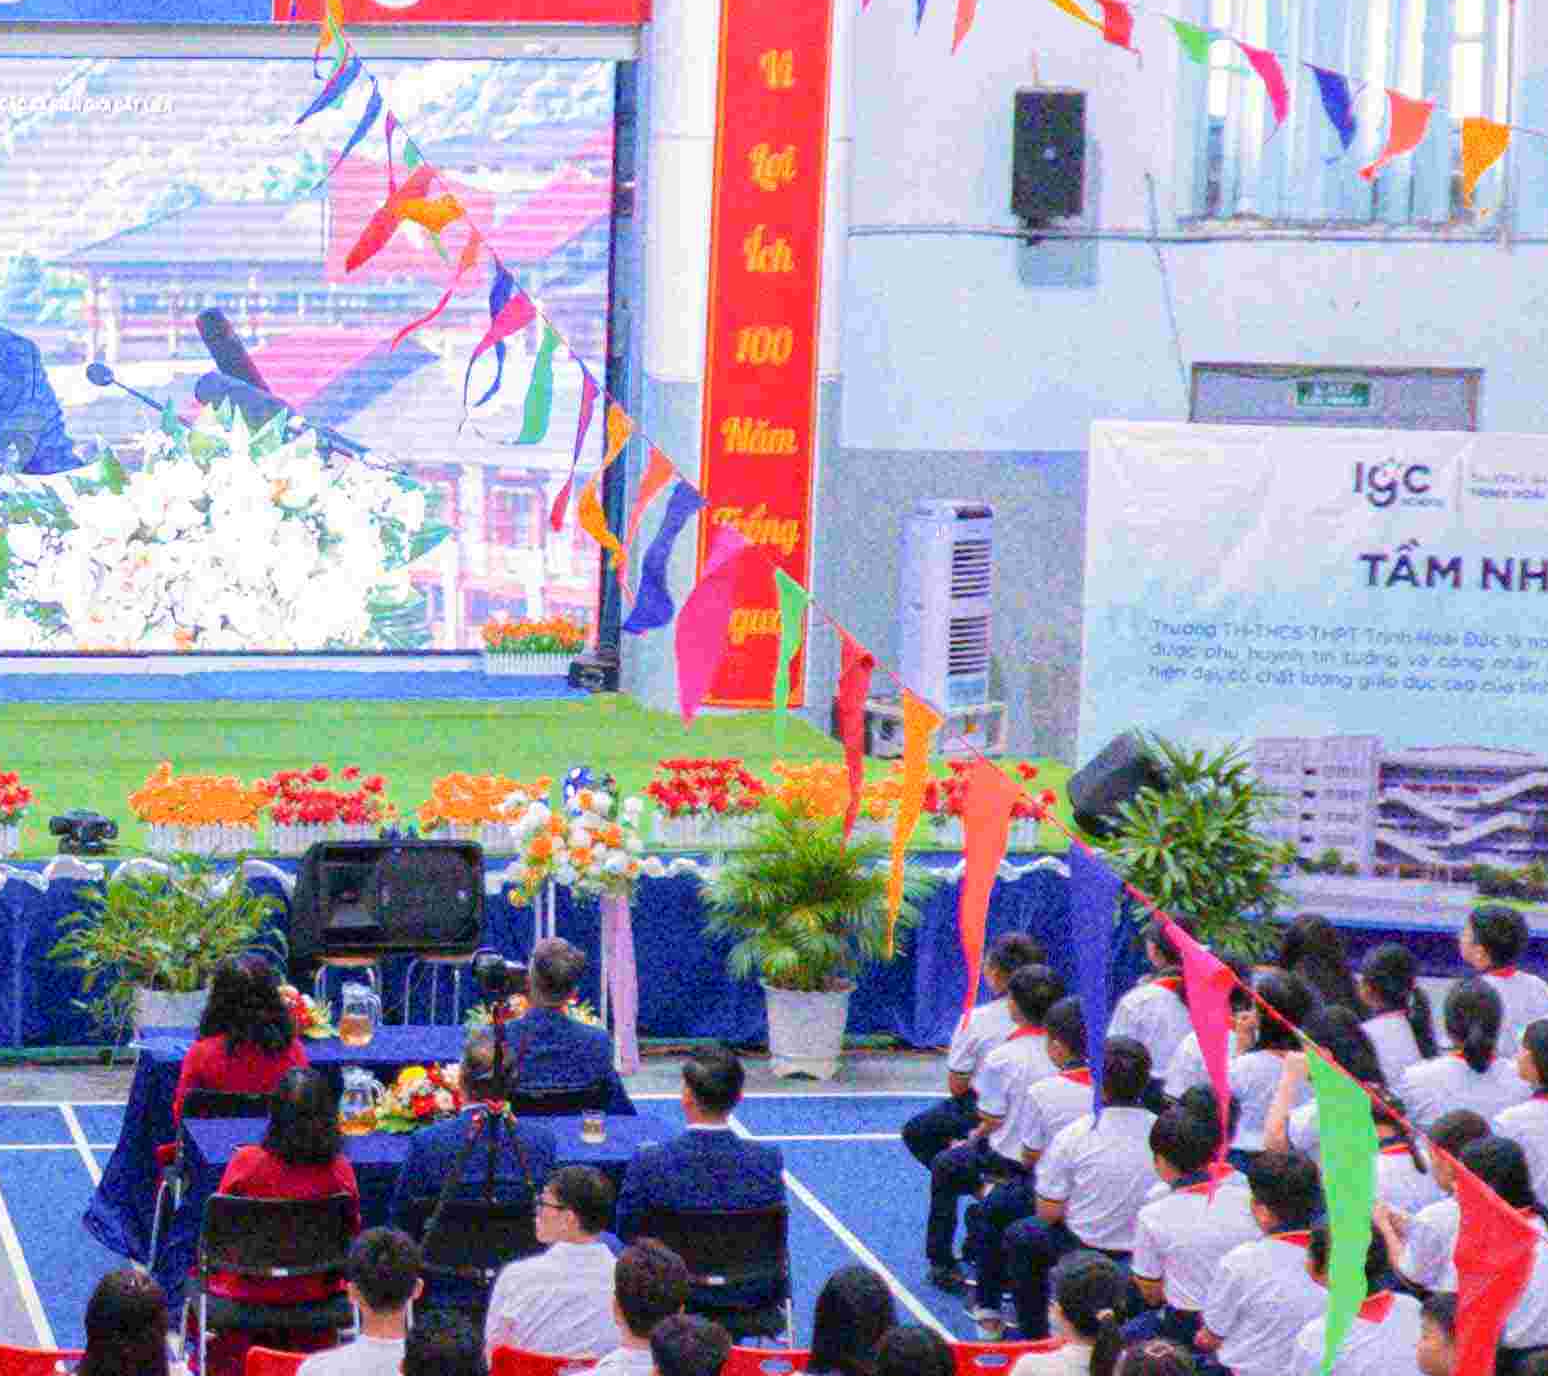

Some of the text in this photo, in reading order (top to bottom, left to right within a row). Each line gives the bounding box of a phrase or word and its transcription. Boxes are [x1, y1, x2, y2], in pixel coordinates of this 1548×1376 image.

[735, 326, 794, 366] 100
[720, 415, 798, 455] Năm
[1357, 537, 1464, 591] TẦM
